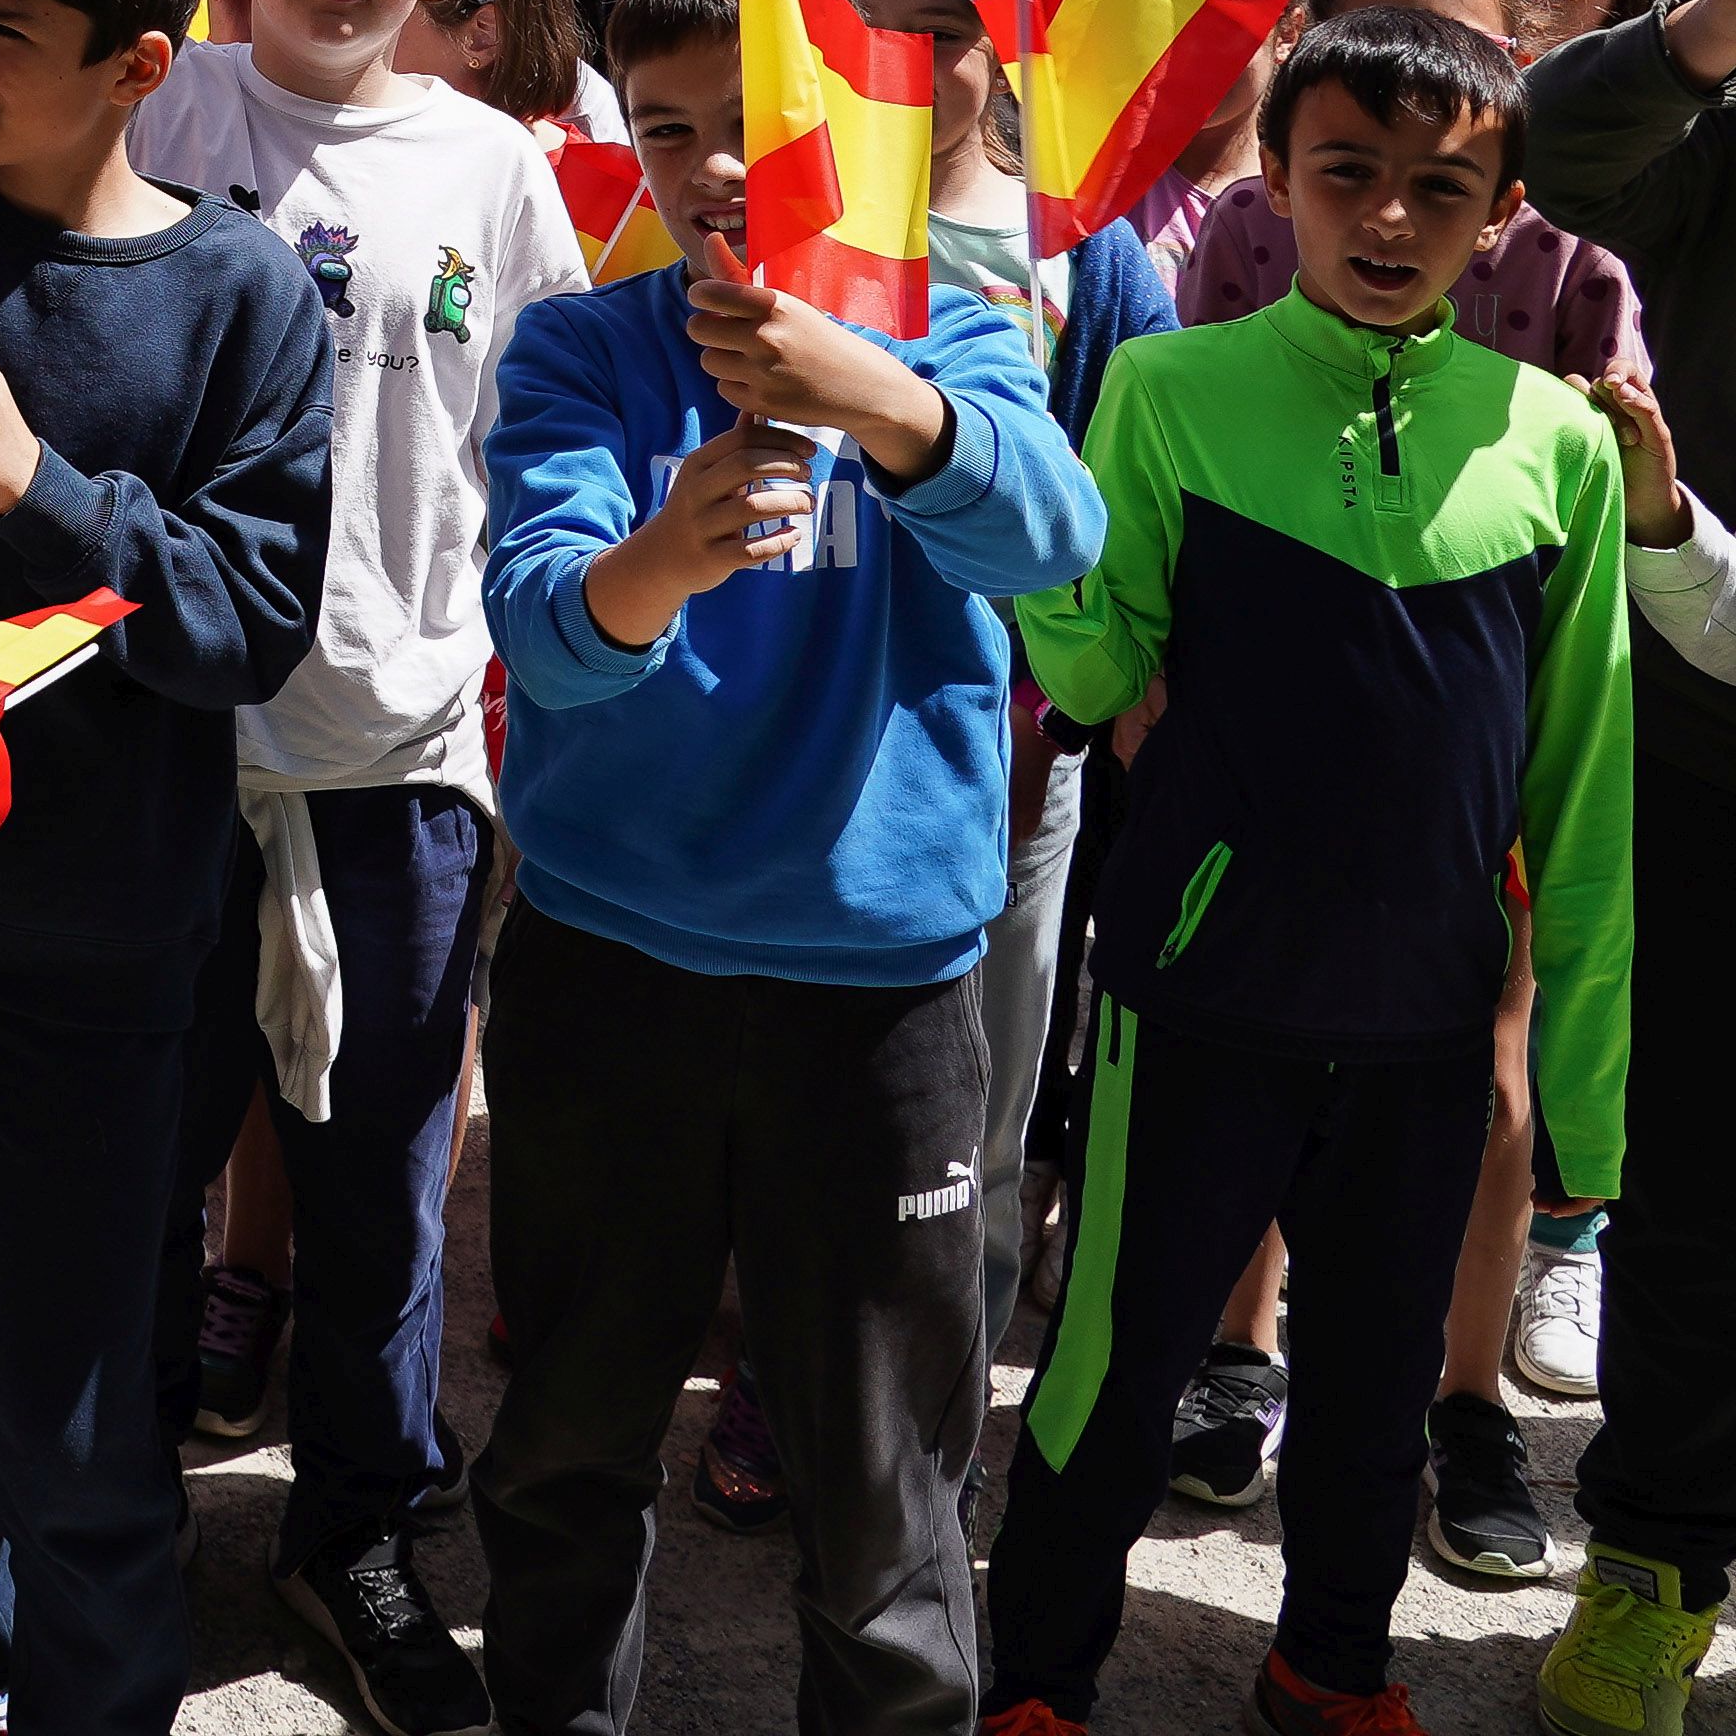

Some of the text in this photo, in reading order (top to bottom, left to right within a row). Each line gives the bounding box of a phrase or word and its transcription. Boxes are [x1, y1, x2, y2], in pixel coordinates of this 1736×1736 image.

[366, 350, 420, 374] you?
[1337, 435, 1360, 510] KIPSTA
[897, 1178, 970, 1222] PUMA
